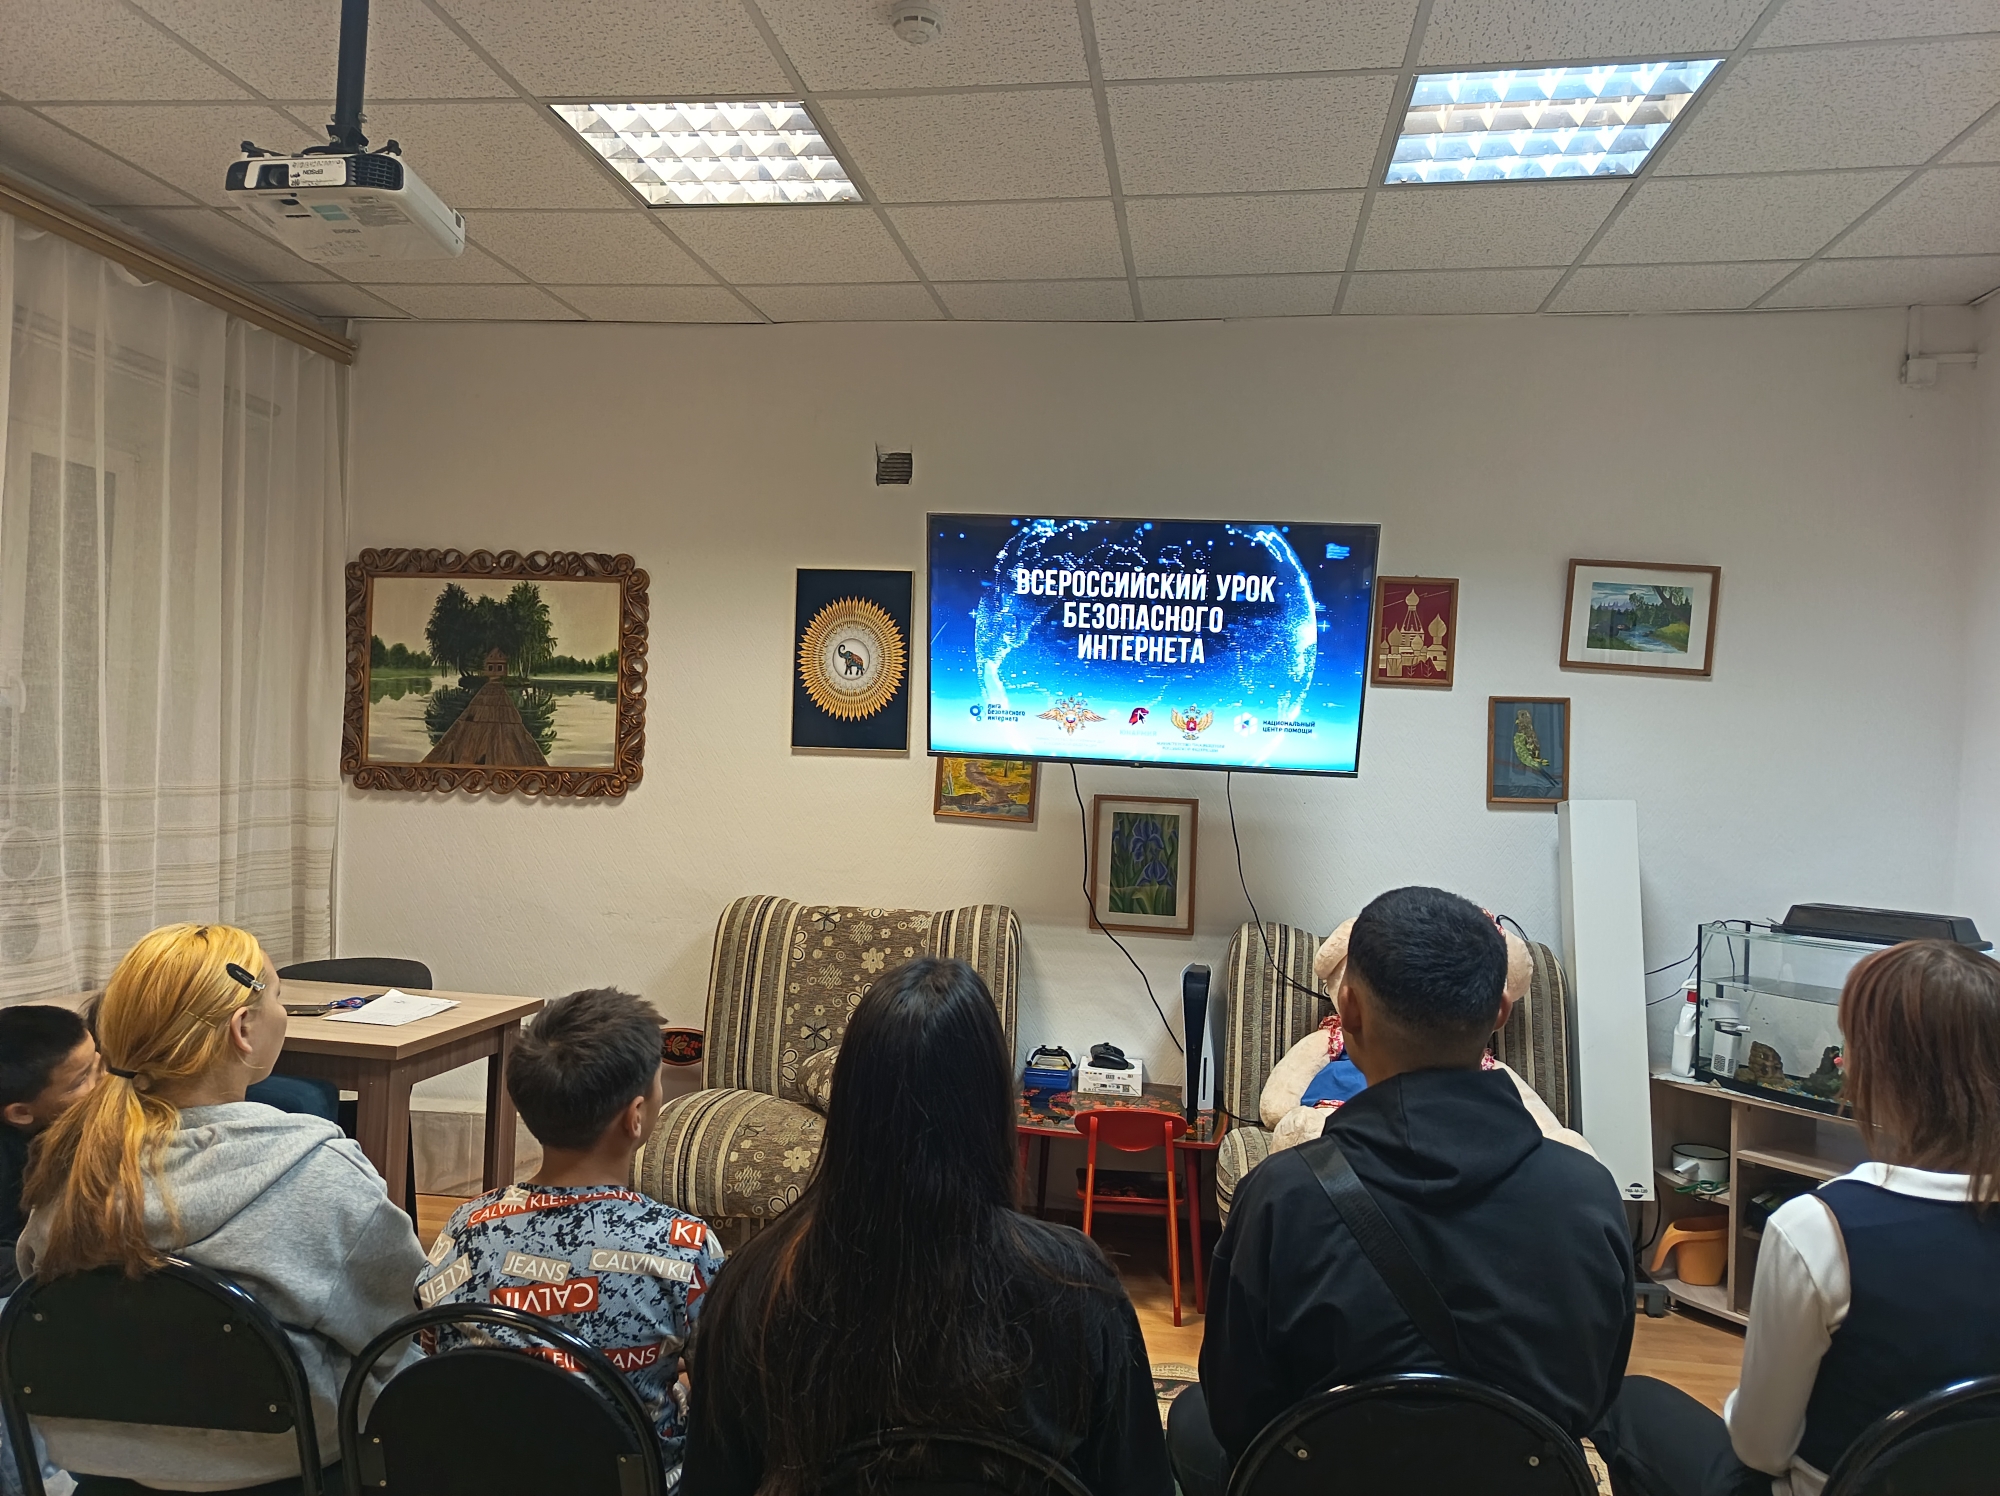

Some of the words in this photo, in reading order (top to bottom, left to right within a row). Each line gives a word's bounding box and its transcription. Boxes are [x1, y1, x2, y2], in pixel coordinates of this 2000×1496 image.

[1017, 566, 1207, 601] ВСЕРОССИЙСКИЙ
[1217, 574, 1276, 602] УРОК
[1063, 601, 1224, 633] БЕЗОПАСНОГО
[1078, 634, 1205, 664] ИНТЕРНЕТА
[505, 1254, 567, 1282] JEANS
[592, 1251, 664, 1276] CALVIN
[604, 1347, 656, 1368] ANS
